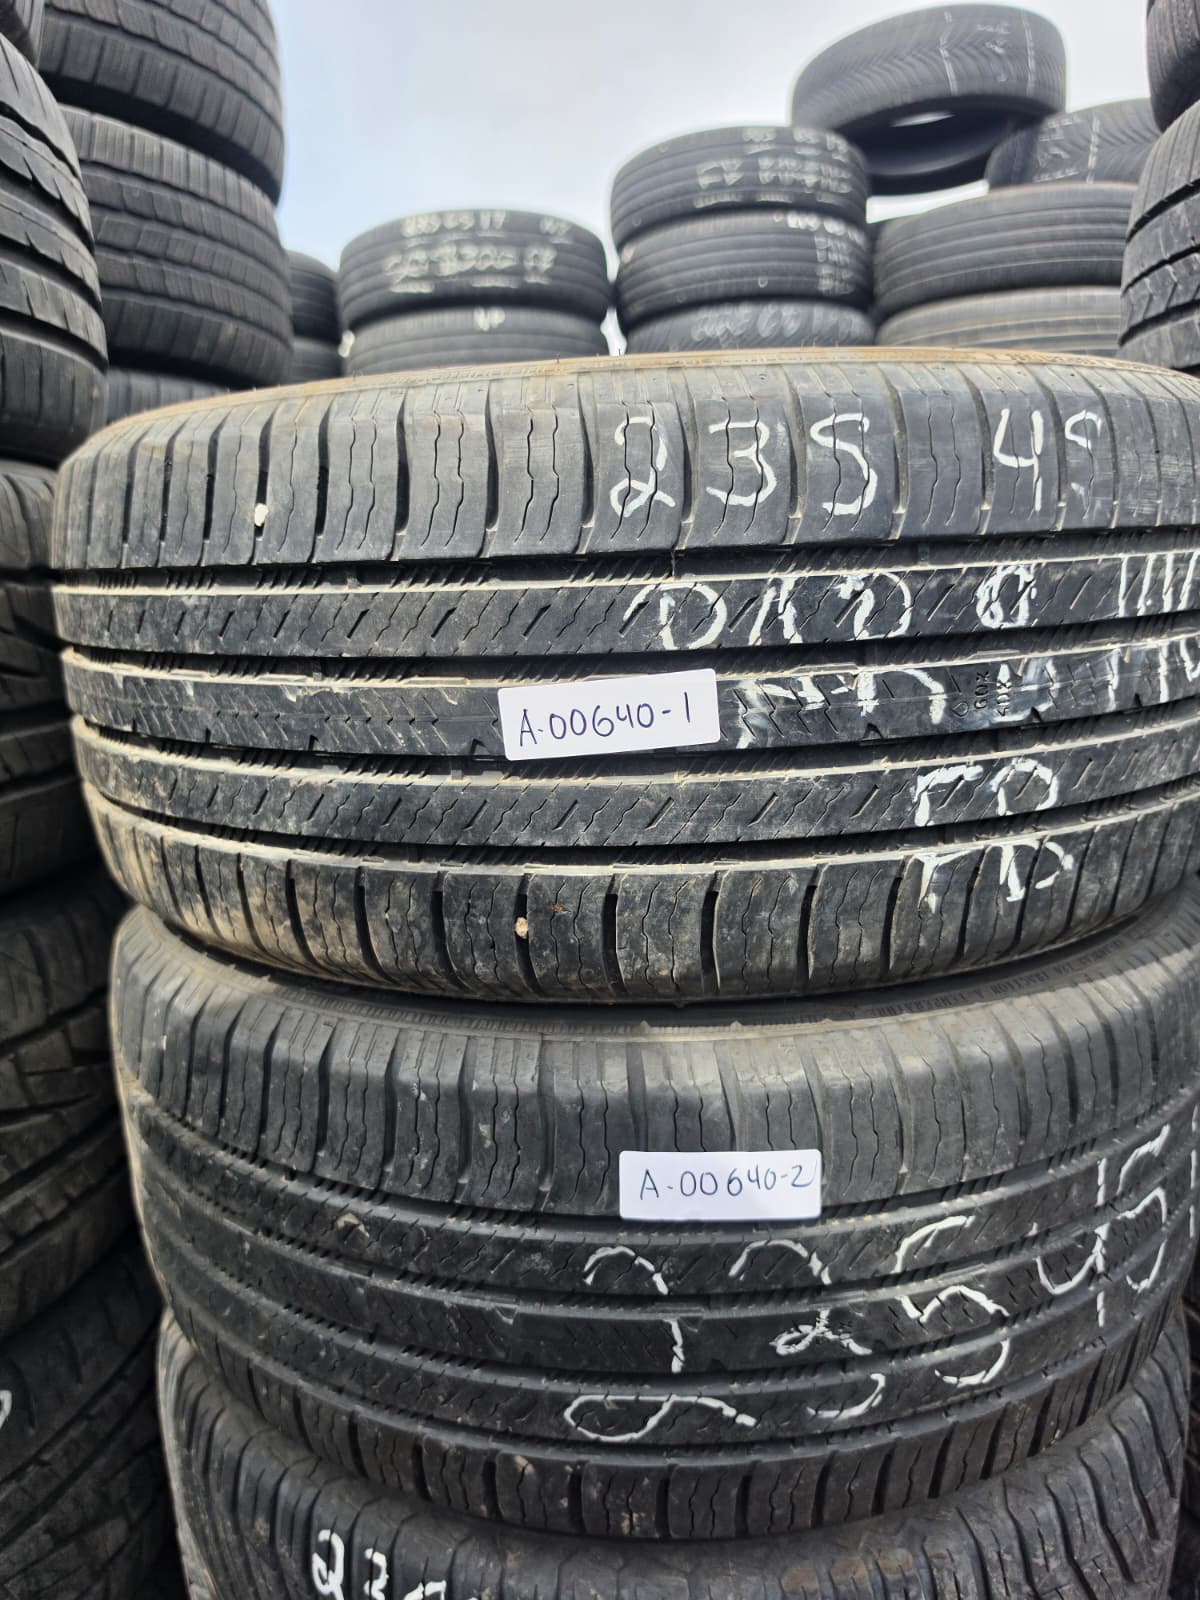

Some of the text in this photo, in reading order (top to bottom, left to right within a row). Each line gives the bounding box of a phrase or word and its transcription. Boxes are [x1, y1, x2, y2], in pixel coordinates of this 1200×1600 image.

[610, 411, 876, 515] 235
[520, 692, 690, 747] A-00640-1
[640, 1164, 818, 1200] A-00640-2
